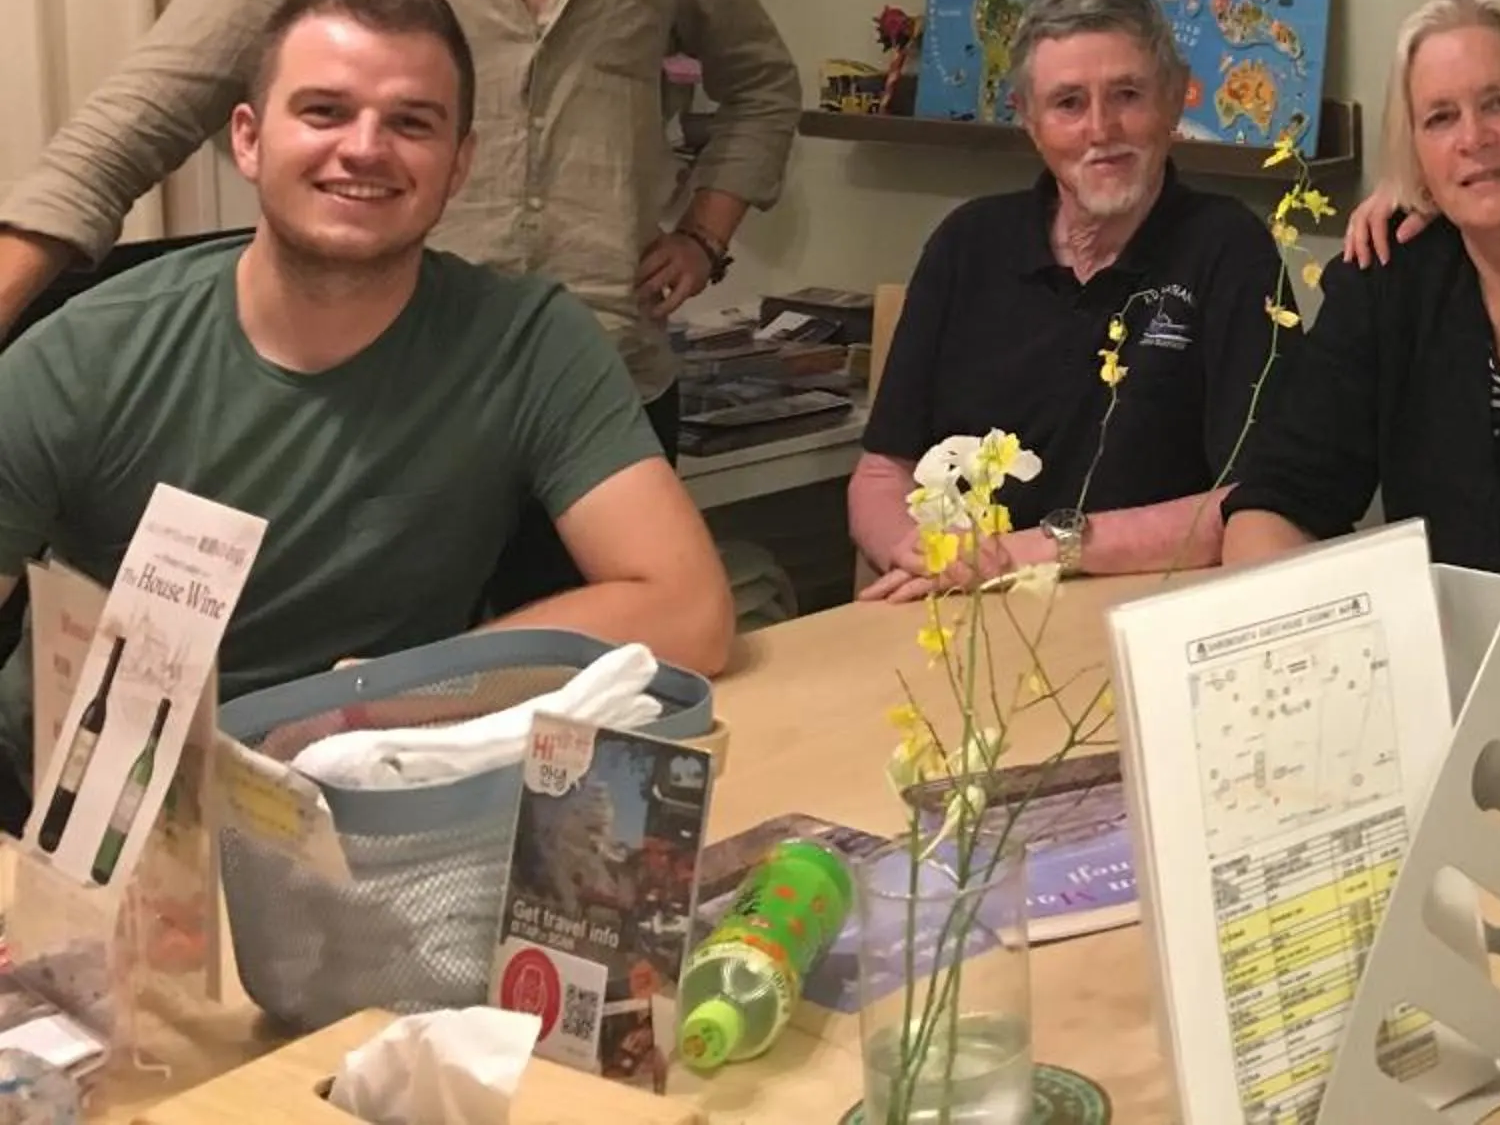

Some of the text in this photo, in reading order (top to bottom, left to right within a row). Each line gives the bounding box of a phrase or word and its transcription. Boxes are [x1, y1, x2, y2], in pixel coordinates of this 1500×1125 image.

[137, 562, 184, 603] House
[186, 580, 226, 620] Wine
[513, 899, 620, 950] Get travel info
